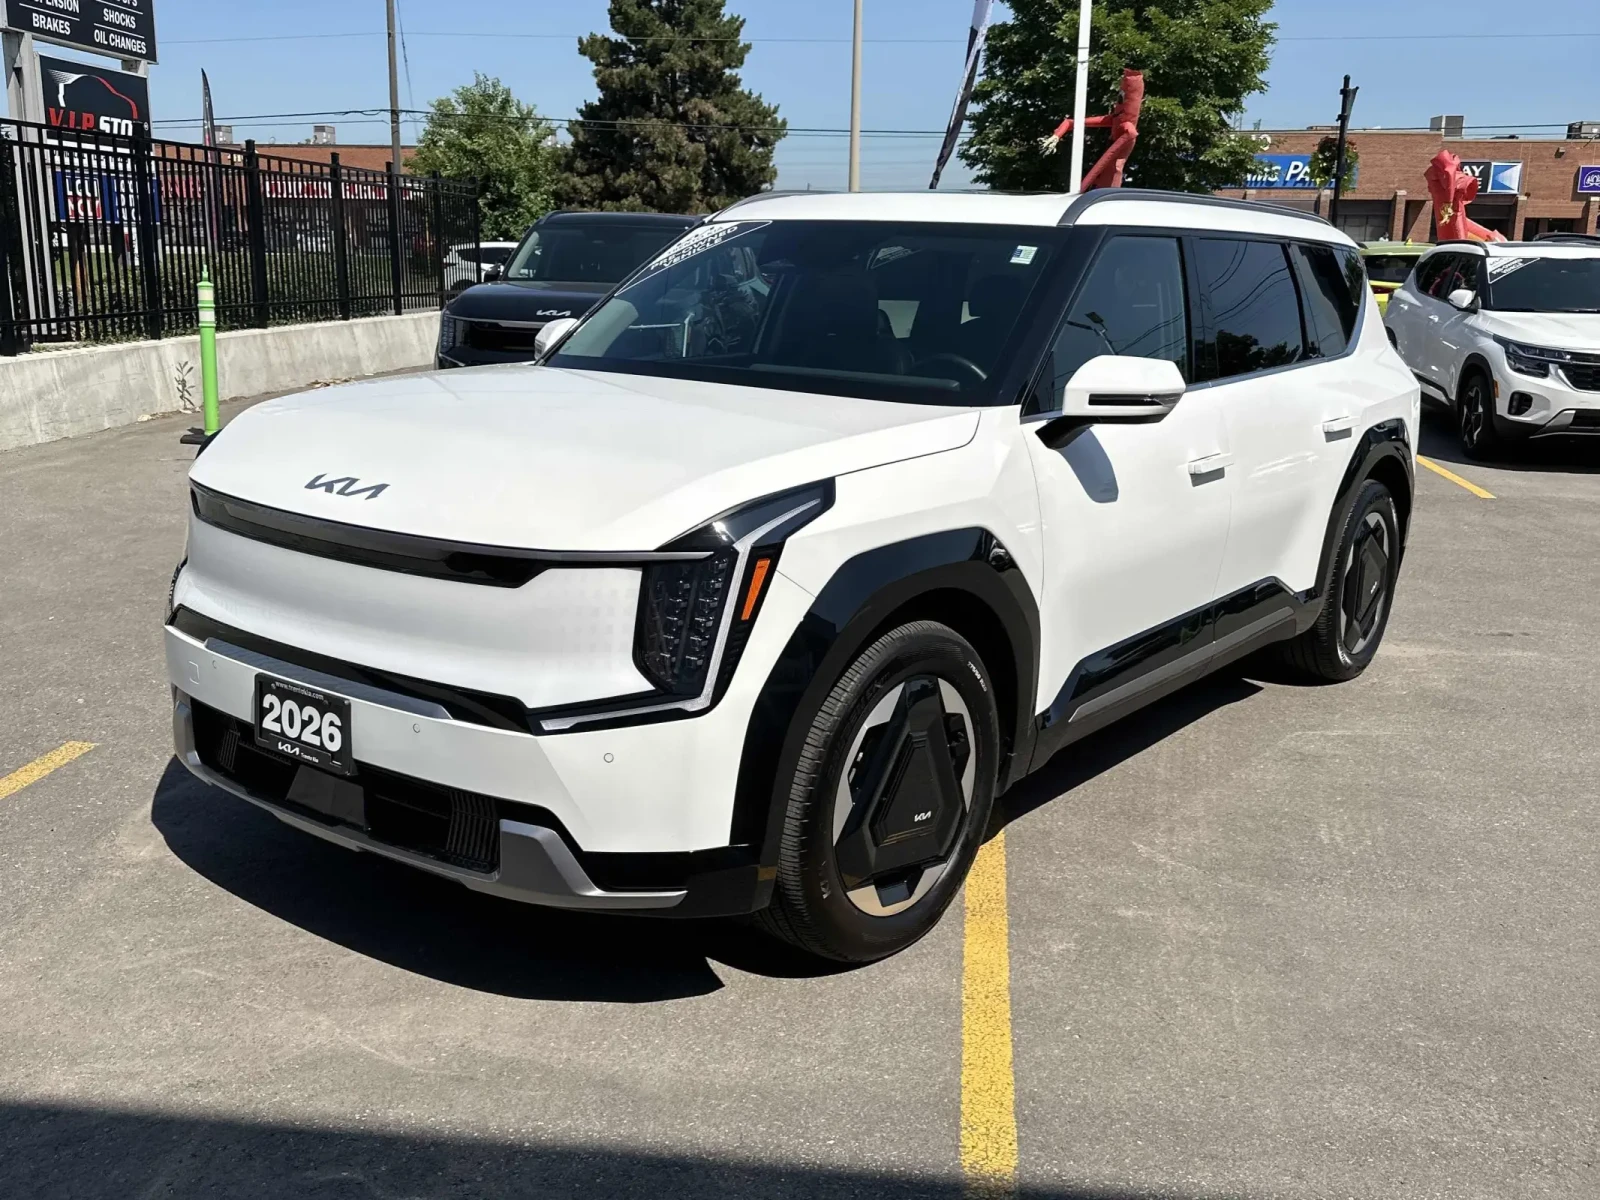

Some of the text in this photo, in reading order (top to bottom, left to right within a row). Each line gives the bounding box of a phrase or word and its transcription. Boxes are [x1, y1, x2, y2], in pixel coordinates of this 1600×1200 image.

[32, 13, 71, 35] BRAKES
[103, 8, 136, 29] SHOCKS
[93, 29, 147, 54] OIL CHANGES
[663, 237, 722, 267] VEHICLE
[304, 472, 391, 500] KIA
[262, 693, 342, 752] 2026
[278, 741, 300, 755] KIA
